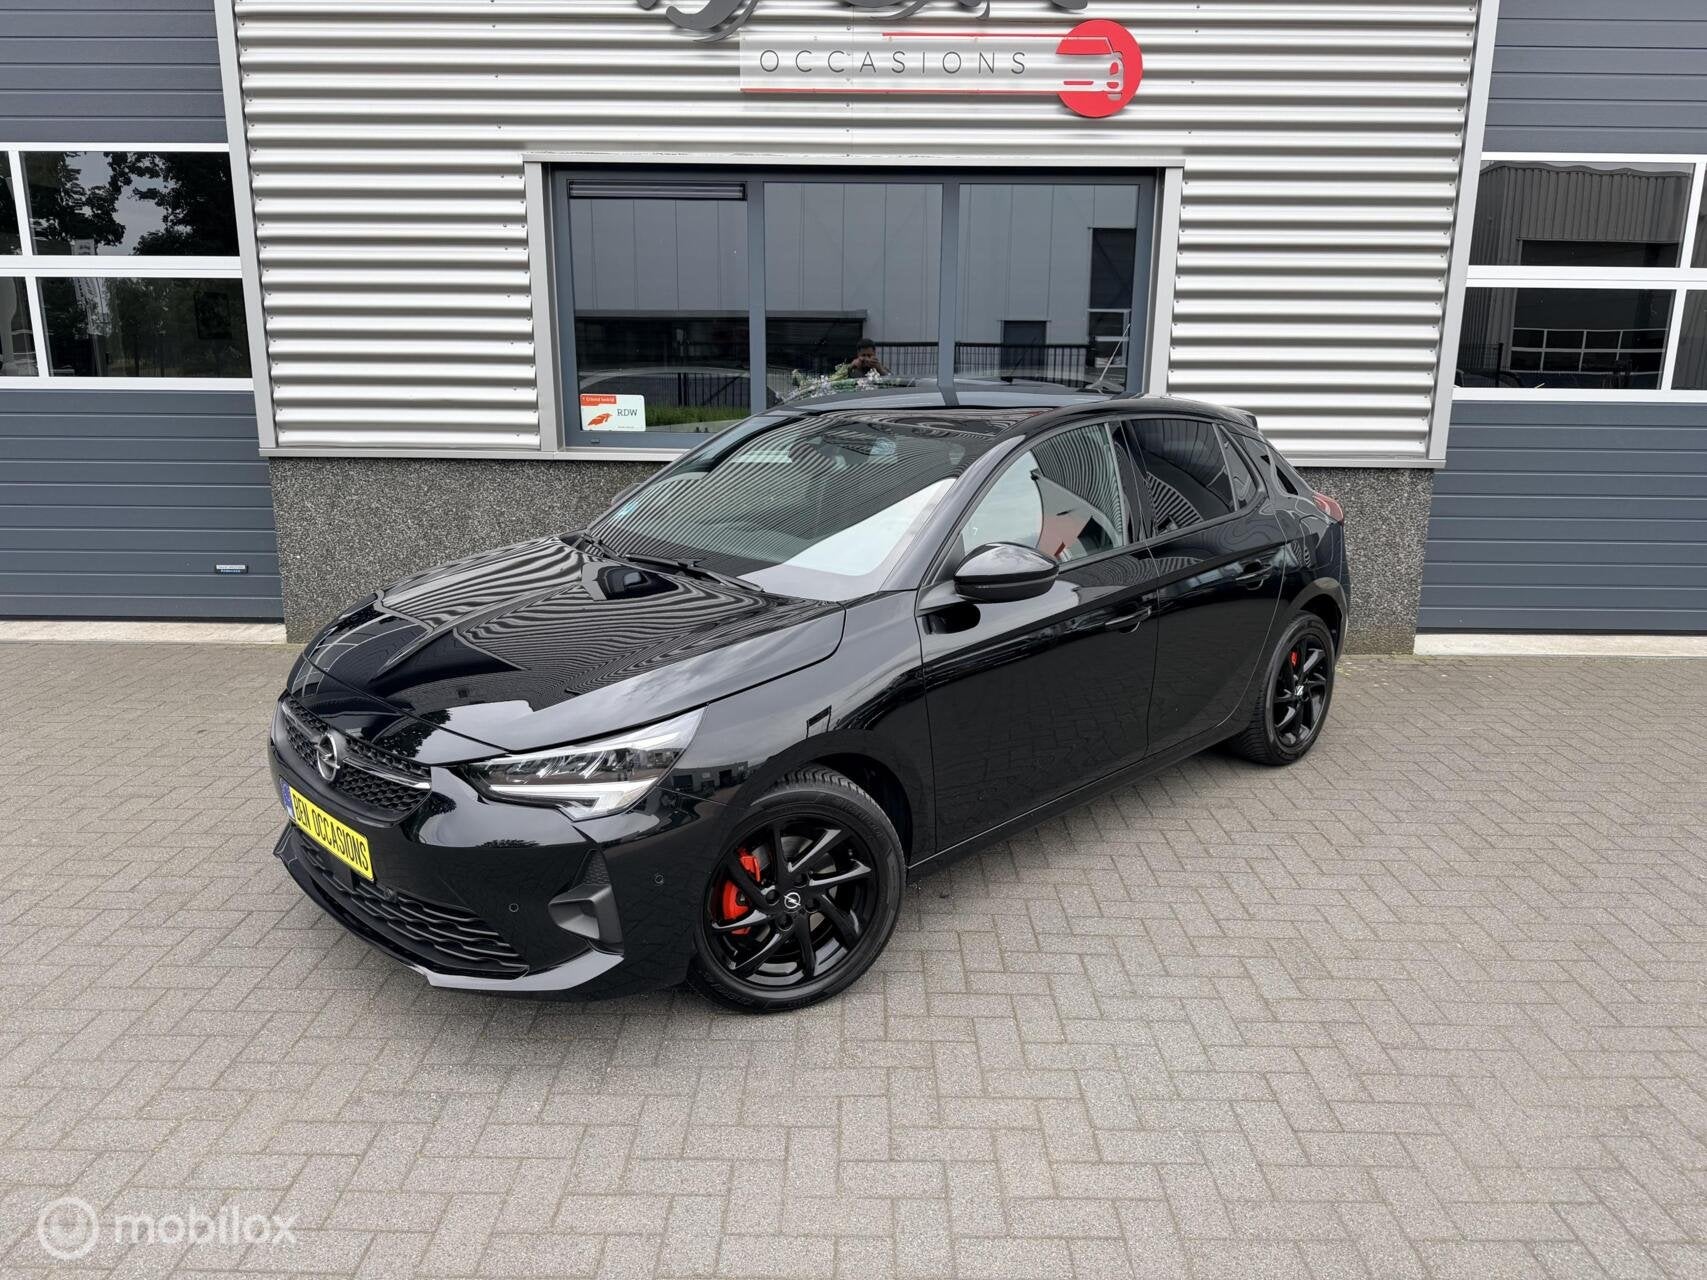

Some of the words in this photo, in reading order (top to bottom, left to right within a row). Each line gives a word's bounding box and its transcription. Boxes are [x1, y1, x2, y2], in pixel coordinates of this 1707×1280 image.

[759, 49, 1028, 75] OCCASIONS
[616, 408, 638, 417] RDW
[311, 808, 369, 872] OCCASIONS
